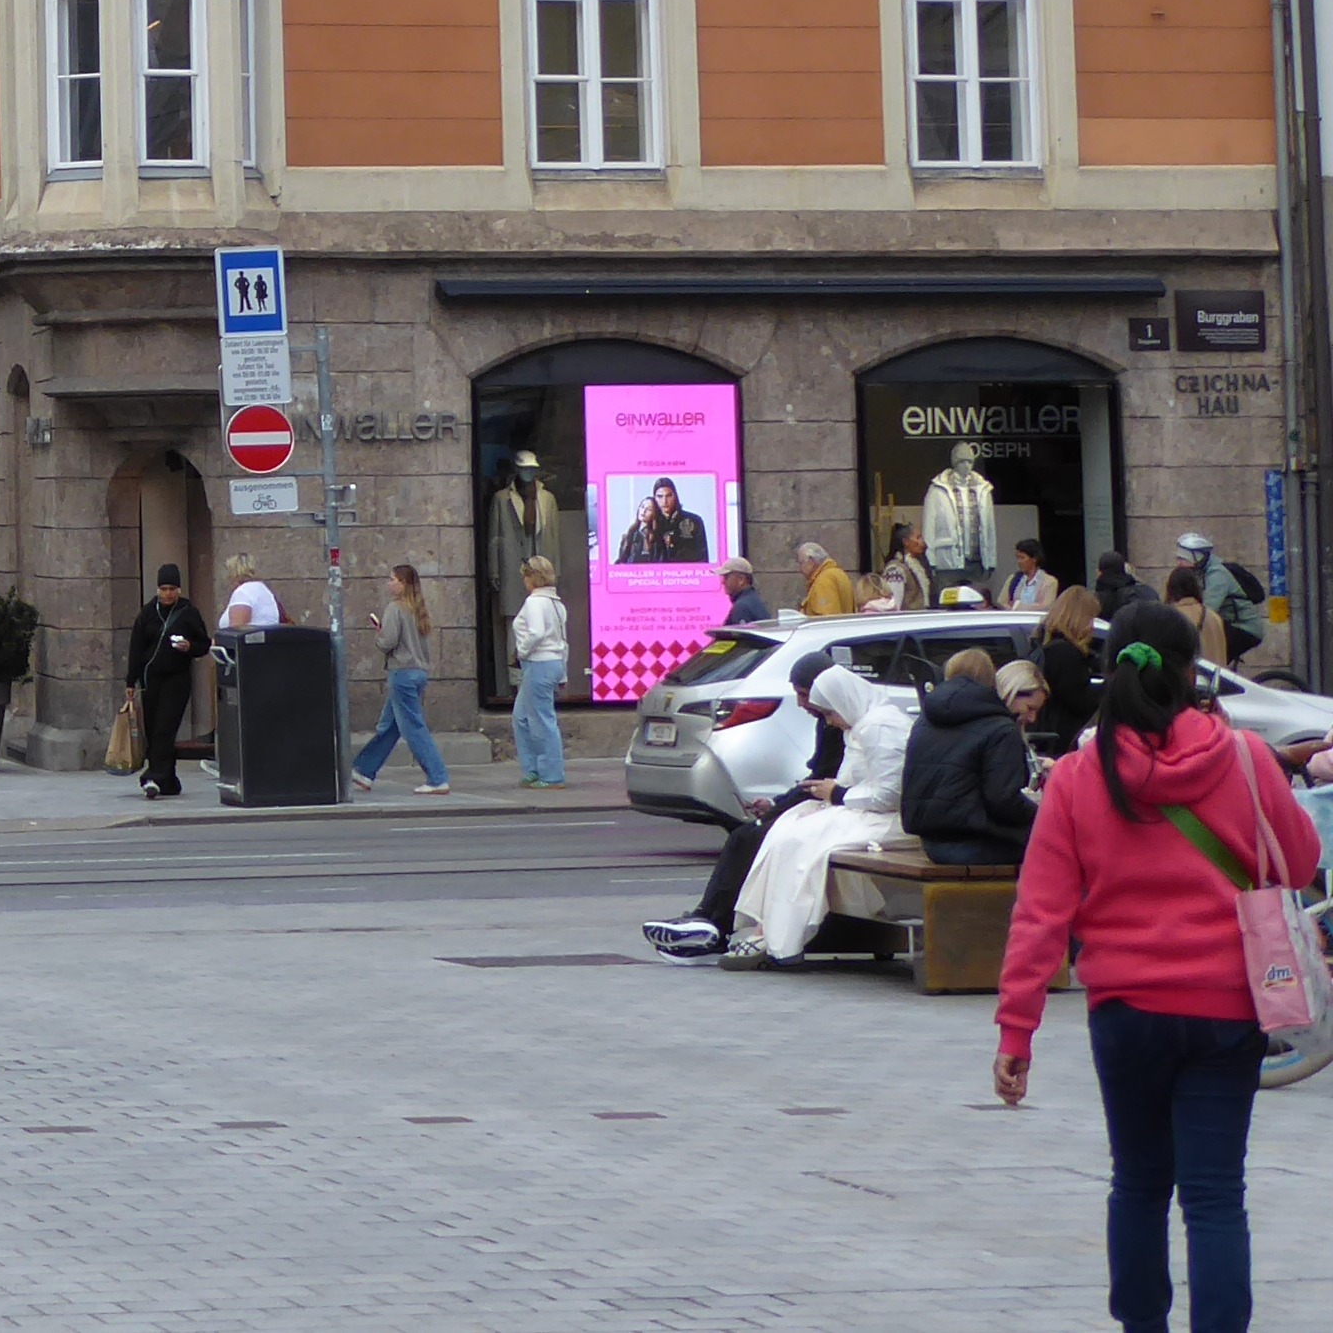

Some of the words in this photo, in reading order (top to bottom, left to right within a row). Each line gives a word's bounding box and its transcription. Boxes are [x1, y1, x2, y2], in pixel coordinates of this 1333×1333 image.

[1197, 310, 1259, 325] Burggraben
[1145, 324, 1153, 338] 1
[968, 441, 1031, 459] OSEPH
[233, 481, 294, 493] ausgenommen
[608, 570, 654, 578] EINWALLER
[627, 578, 661, 586] SPECIAL
[662, 577, 700, 586] EDITIONS
[1267, 966, 1291, 980] dm
